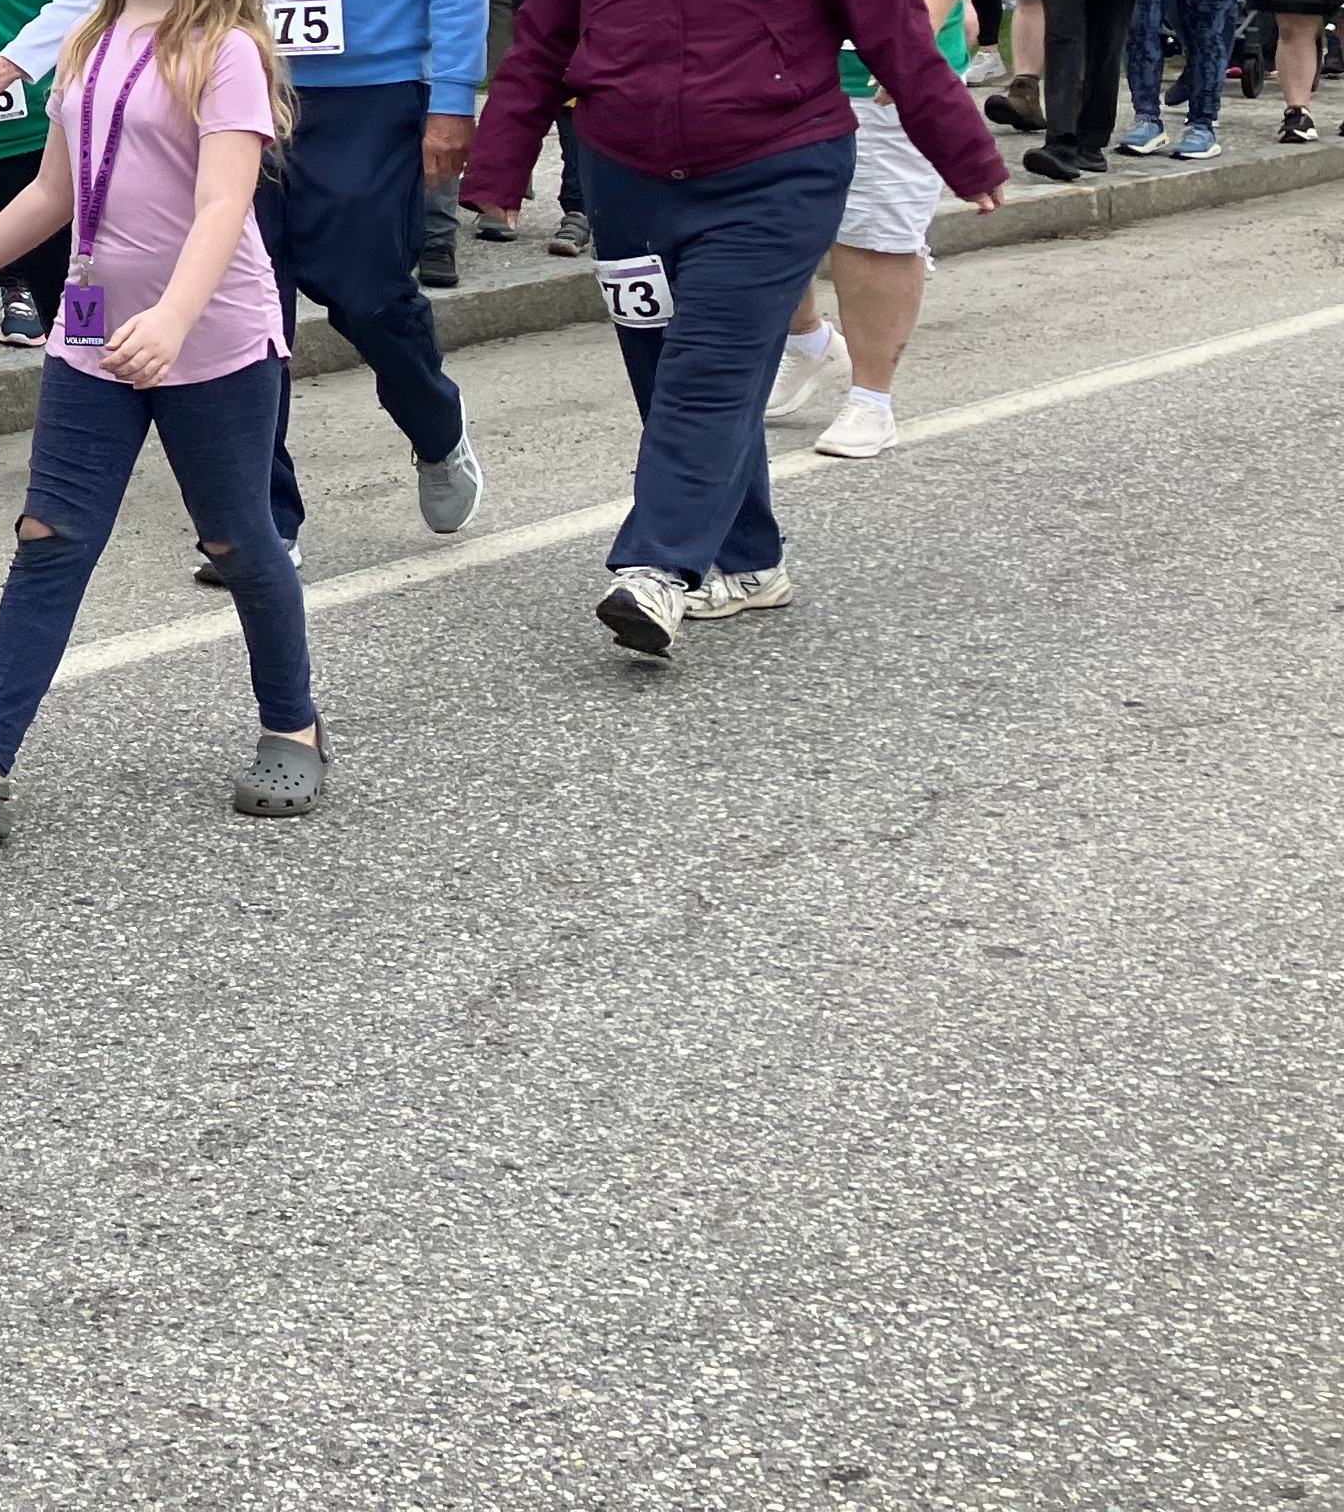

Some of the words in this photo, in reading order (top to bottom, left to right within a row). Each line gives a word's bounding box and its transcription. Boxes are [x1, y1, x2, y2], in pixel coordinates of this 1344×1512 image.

[274, 6, 329, 45] 75
[601, 280, 661, 318] 73
[65, 336, 104, 345] VOLUNTEER
